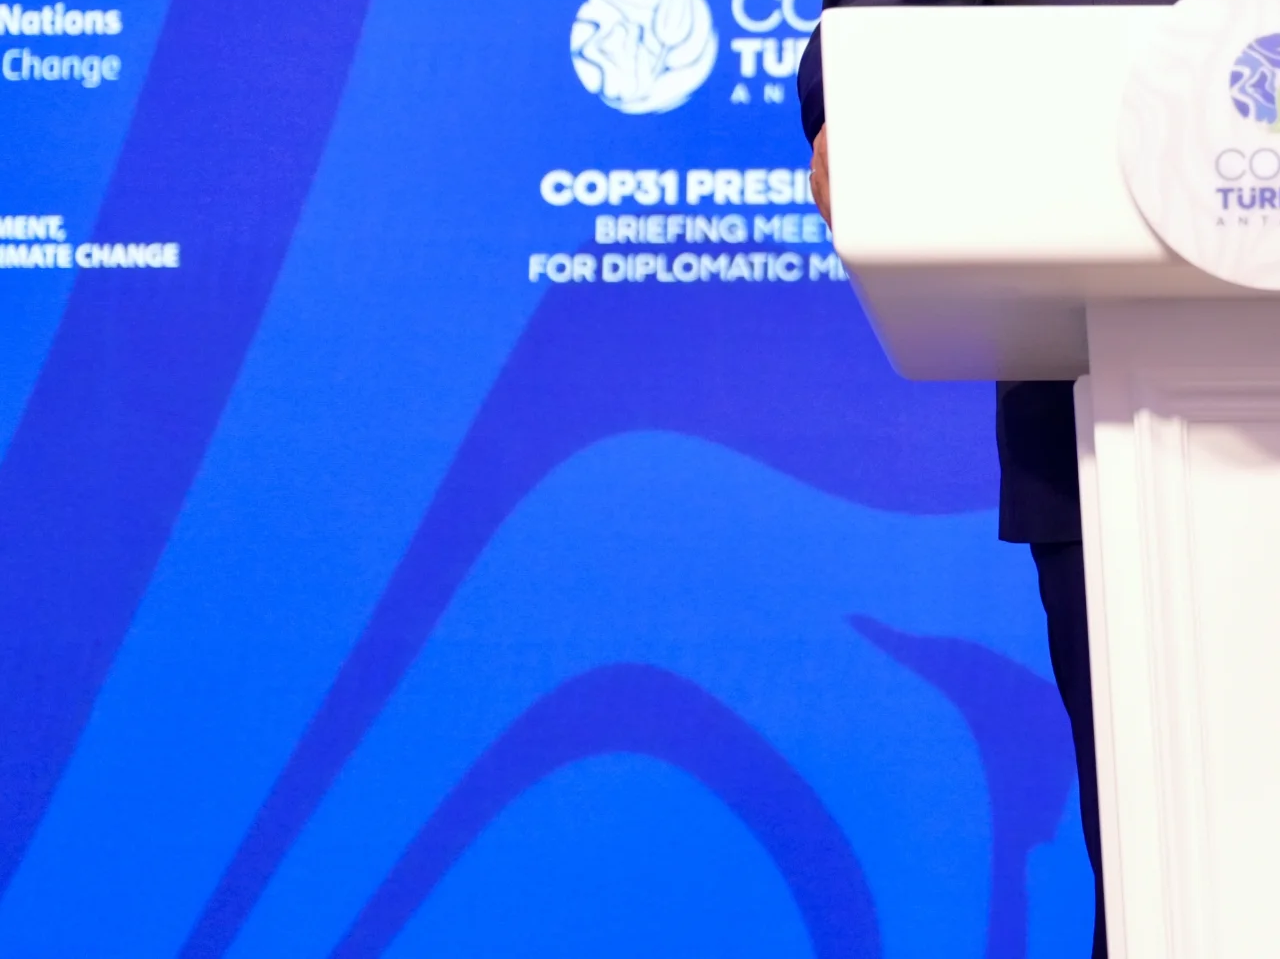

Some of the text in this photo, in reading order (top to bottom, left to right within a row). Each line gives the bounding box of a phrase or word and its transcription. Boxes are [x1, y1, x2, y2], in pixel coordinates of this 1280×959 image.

[0, 2, 123, 36] Nations
[2, 47, 122, 88] Change
[539, 169, 679, 206] COP31
[594, 213, 749, 244] BRIEFING
[75, 242, 180, 269] CHANGE
[528, 252, 598, 283] FOR
[601, 251, 804, 284] DIPLOMATIC
